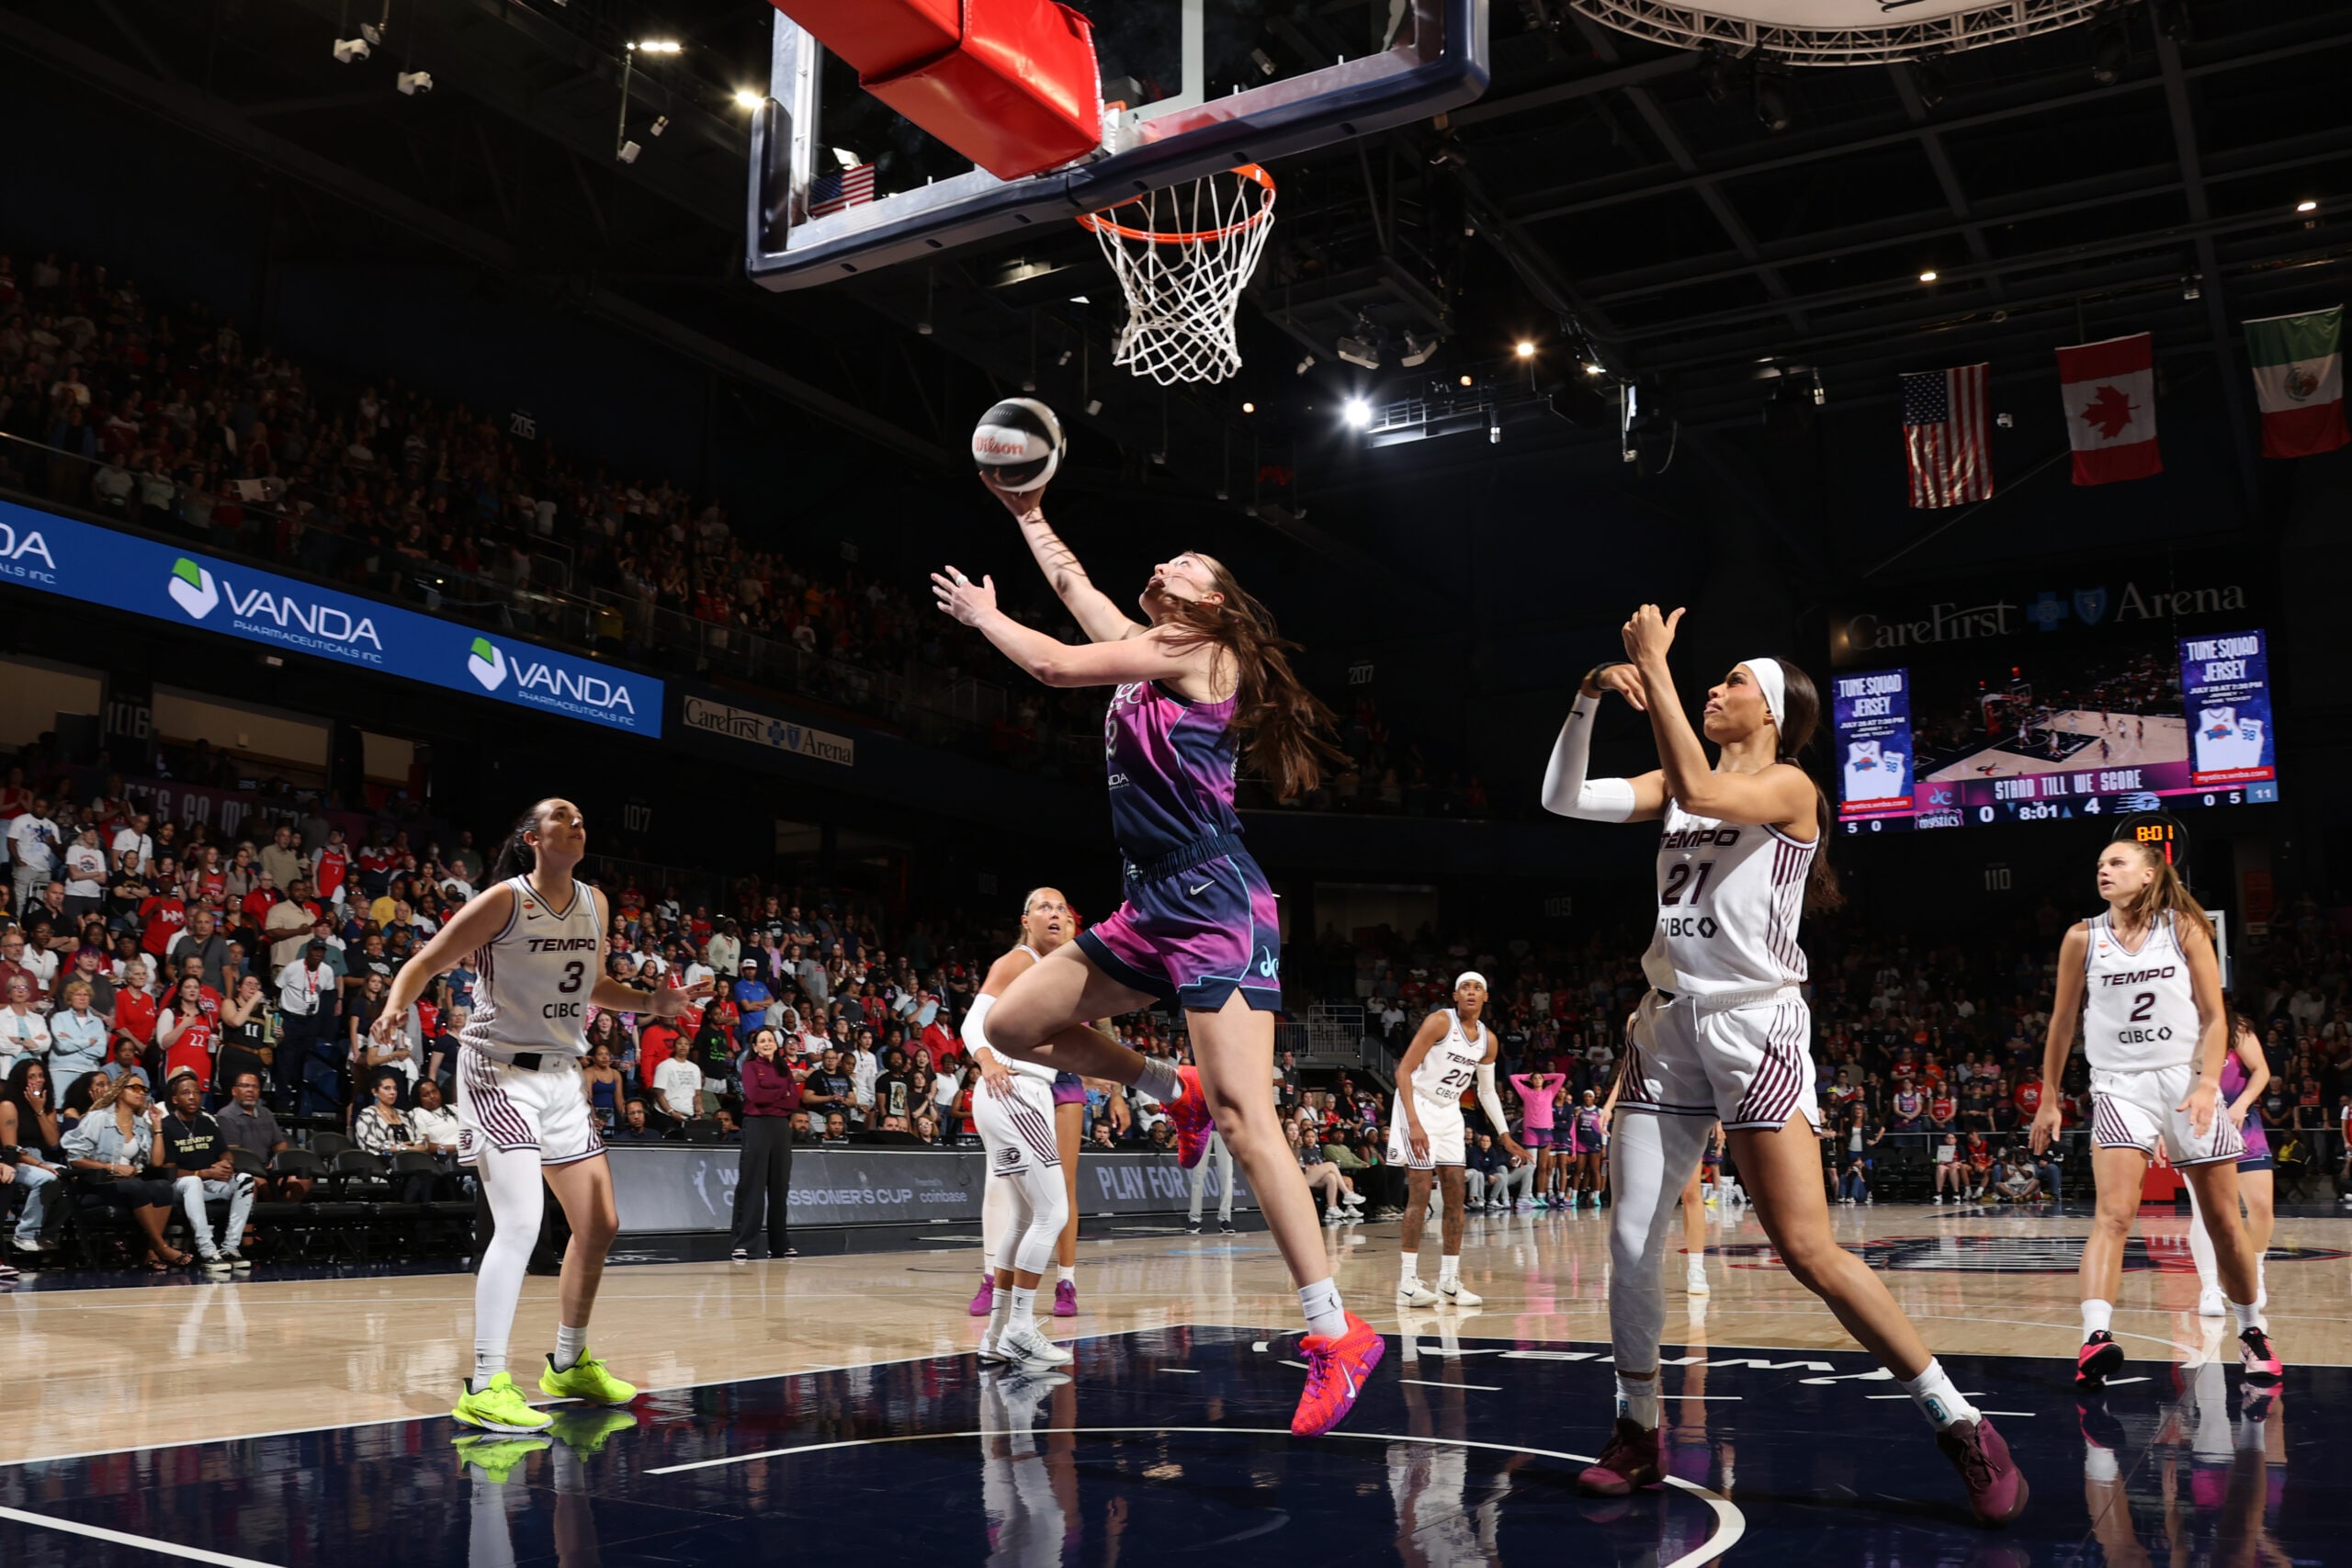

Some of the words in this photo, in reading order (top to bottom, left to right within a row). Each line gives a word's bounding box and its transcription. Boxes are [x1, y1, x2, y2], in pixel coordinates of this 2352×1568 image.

[509, 412, 537, 441] 205
[222, 580, 383, 651] VANDA
[1846, 599, 2018, 652] CareFirst
[2114, 581, 2249, 623] Arena
[233, 619, 359, 659] PHARMACEUTICALS
[2217, 635, 2259, 660] SQUAD
[1347, 664, 1374, 685] 207
[2201, 660, 2247, 682] JERSEY
[509, 656, 636, 716] VANDA
[1866, 673, 1903, 696] SQUAD
[518, 690, 617, 723] PHARMACEUTICALS
[1851, 695, 1892, 718] JERSEY
[107, 701, 150, 739] 106
[685, 698, 765, 741] CareFirst
[801, 729, 852, 764] Arena
[1995, 779, 2035, 800] STAND
[2041, 775, 2068, 796] TILL
[2074, 773, 2095, 794] WE
[2100, 769, 2143, 791] SCORE
[1979, 806, 1995, 823] 0
[2018, 805, 2058, 820] 8:01
[2084, 797, 2101, 814] 4
[2203, 794, 2215, 807] 0
[2229, 792, 2242, 805] 5
[2255, 788, 2272, 799] 11
[624, 804, 651, 833] 107
[1847, 822, 1858, 834] 5
[1871, 820, 1882, 832] 0
[1660, 829, 1741, 850] TEMPO
[2135, 823, 2175, 843] 8:01
[1660, 862, 1714, 907] 21
[1984, 868, 2011, 891] 110
[1660, 917, 1695, 938] IBC
[526, 938, 596, 953] TEMPO
[558, 960, 585, 994] 3
[2100, 965, 2176, 987] TEMPO
[542, 1002, 581, 1020] CIBC
[2129, 992, 2156, 1022] 2
[189, 1032, 205, 1047] 22
[244, 1022, 258, 1038] 11
[2118, 1029, 2156, 1044] CIBC
[1440, 1068, 1472, 1089] 20
[1096, 1166, 1148, 1200] PLAY
[1146, 1165, 1191, 1199] FOR
[723, 1188, 875, 1207] CSSIONER'S
[876, 1188, 912, 1206] CUP
[920, 1189, 968, 1204] coinbase
